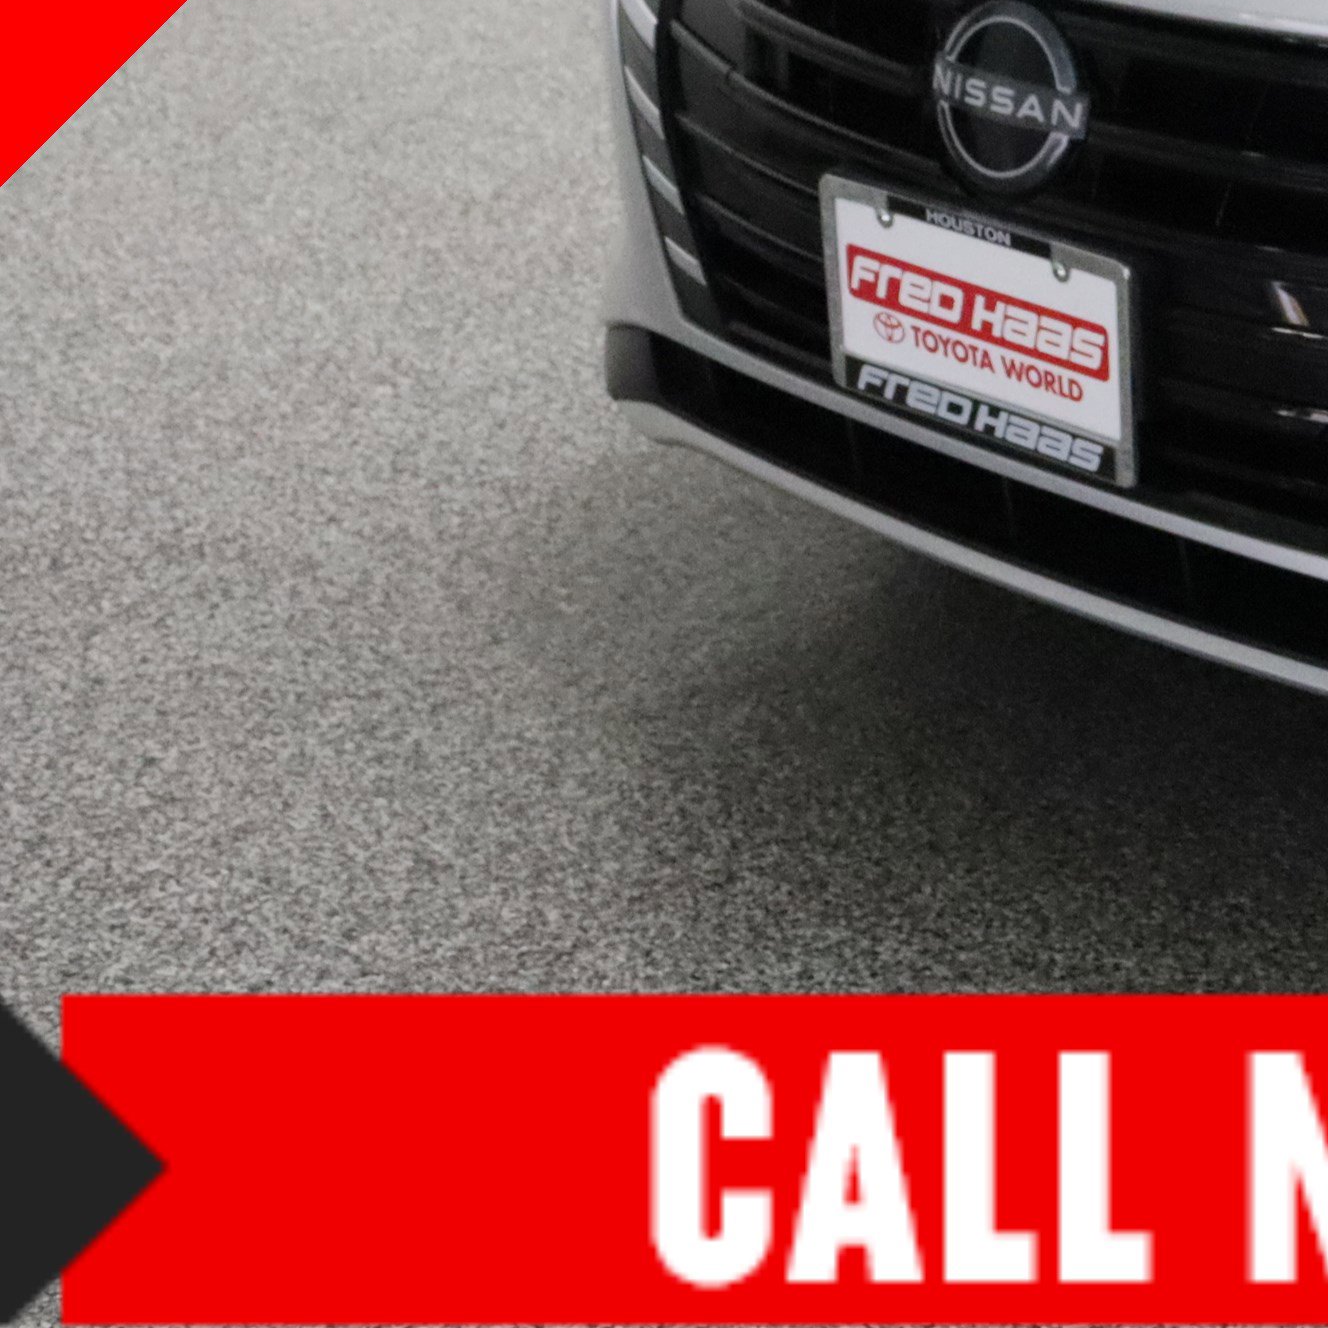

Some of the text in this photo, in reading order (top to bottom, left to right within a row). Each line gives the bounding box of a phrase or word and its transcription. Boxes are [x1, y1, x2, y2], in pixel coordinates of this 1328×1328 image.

[932, 61, 1084, 130] NISSAN
[925, 208, 1012, 248] HOUSTON
[909, 324, 1085, 403] TOYOTA WORLD
